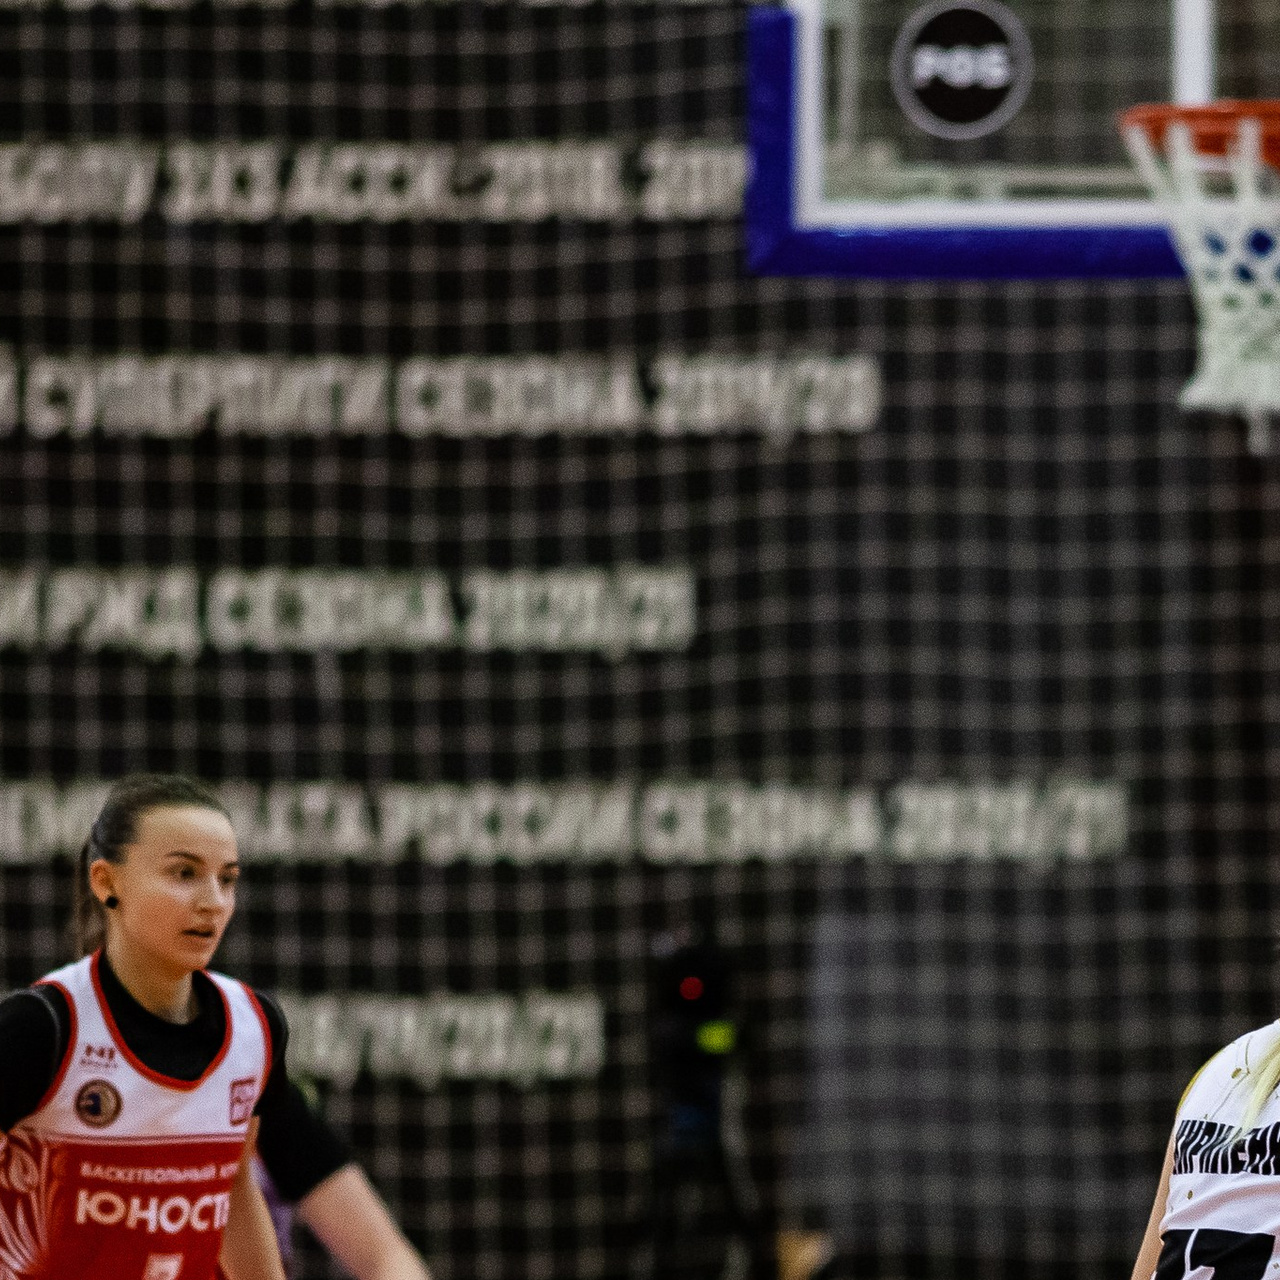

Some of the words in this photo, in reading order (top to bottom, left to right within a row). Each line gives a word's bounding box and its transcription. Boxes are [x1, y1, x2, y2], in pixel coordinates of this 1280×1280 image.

[396, 355, 641, 437] СЕЗОНА
[207, 570, 449, 650] СЕЗОНА
[640, 784, 882, 862] СЕЗОНА
